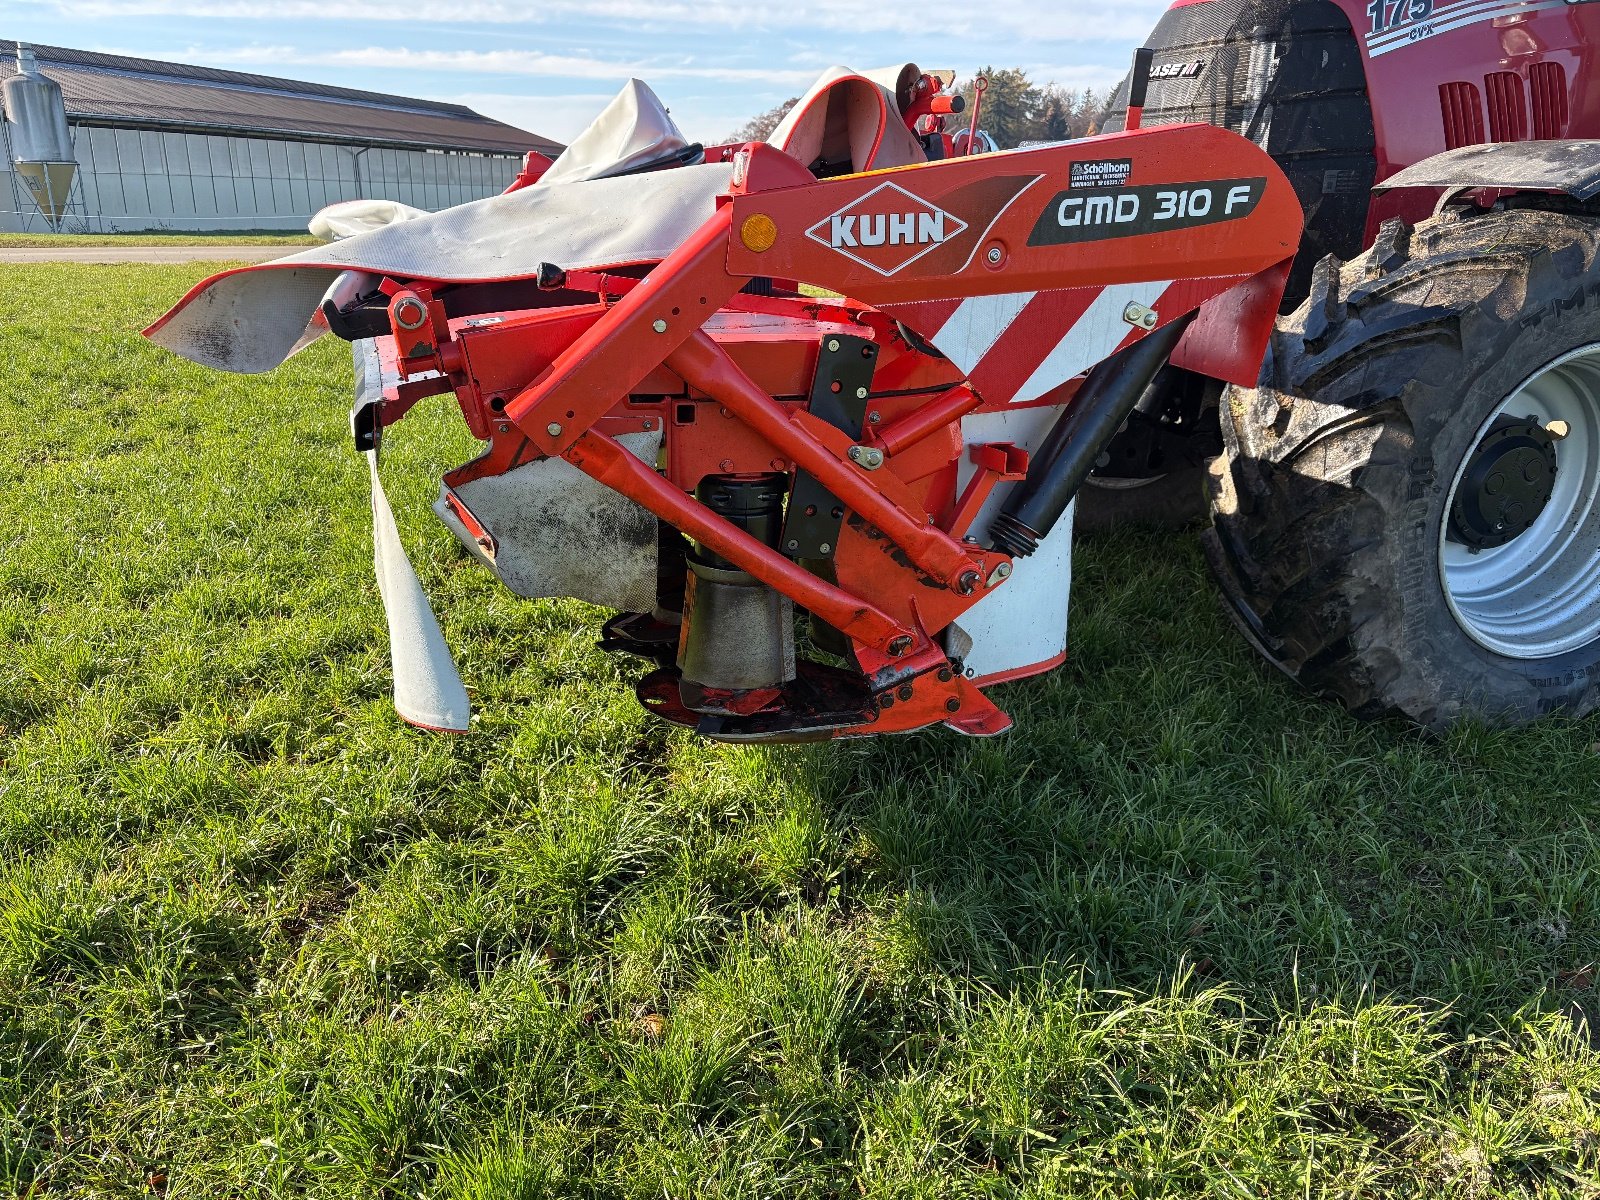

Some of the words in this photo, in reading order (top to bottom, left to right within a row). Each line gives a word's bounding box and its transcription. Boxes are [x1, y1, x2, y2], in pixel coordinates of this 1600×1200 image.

[1366, 0, 1434, 33] 175
[1408, 22, 1435, 40] CVX
[1083, 162, 1130, 175] Schöllhorn
[1057, 194, 1140, 227] GMD
[1152, 188, 1212, 220] 310
[1224, 185, 1251, 215] F
[831, 210, 945, 248] KUHN
